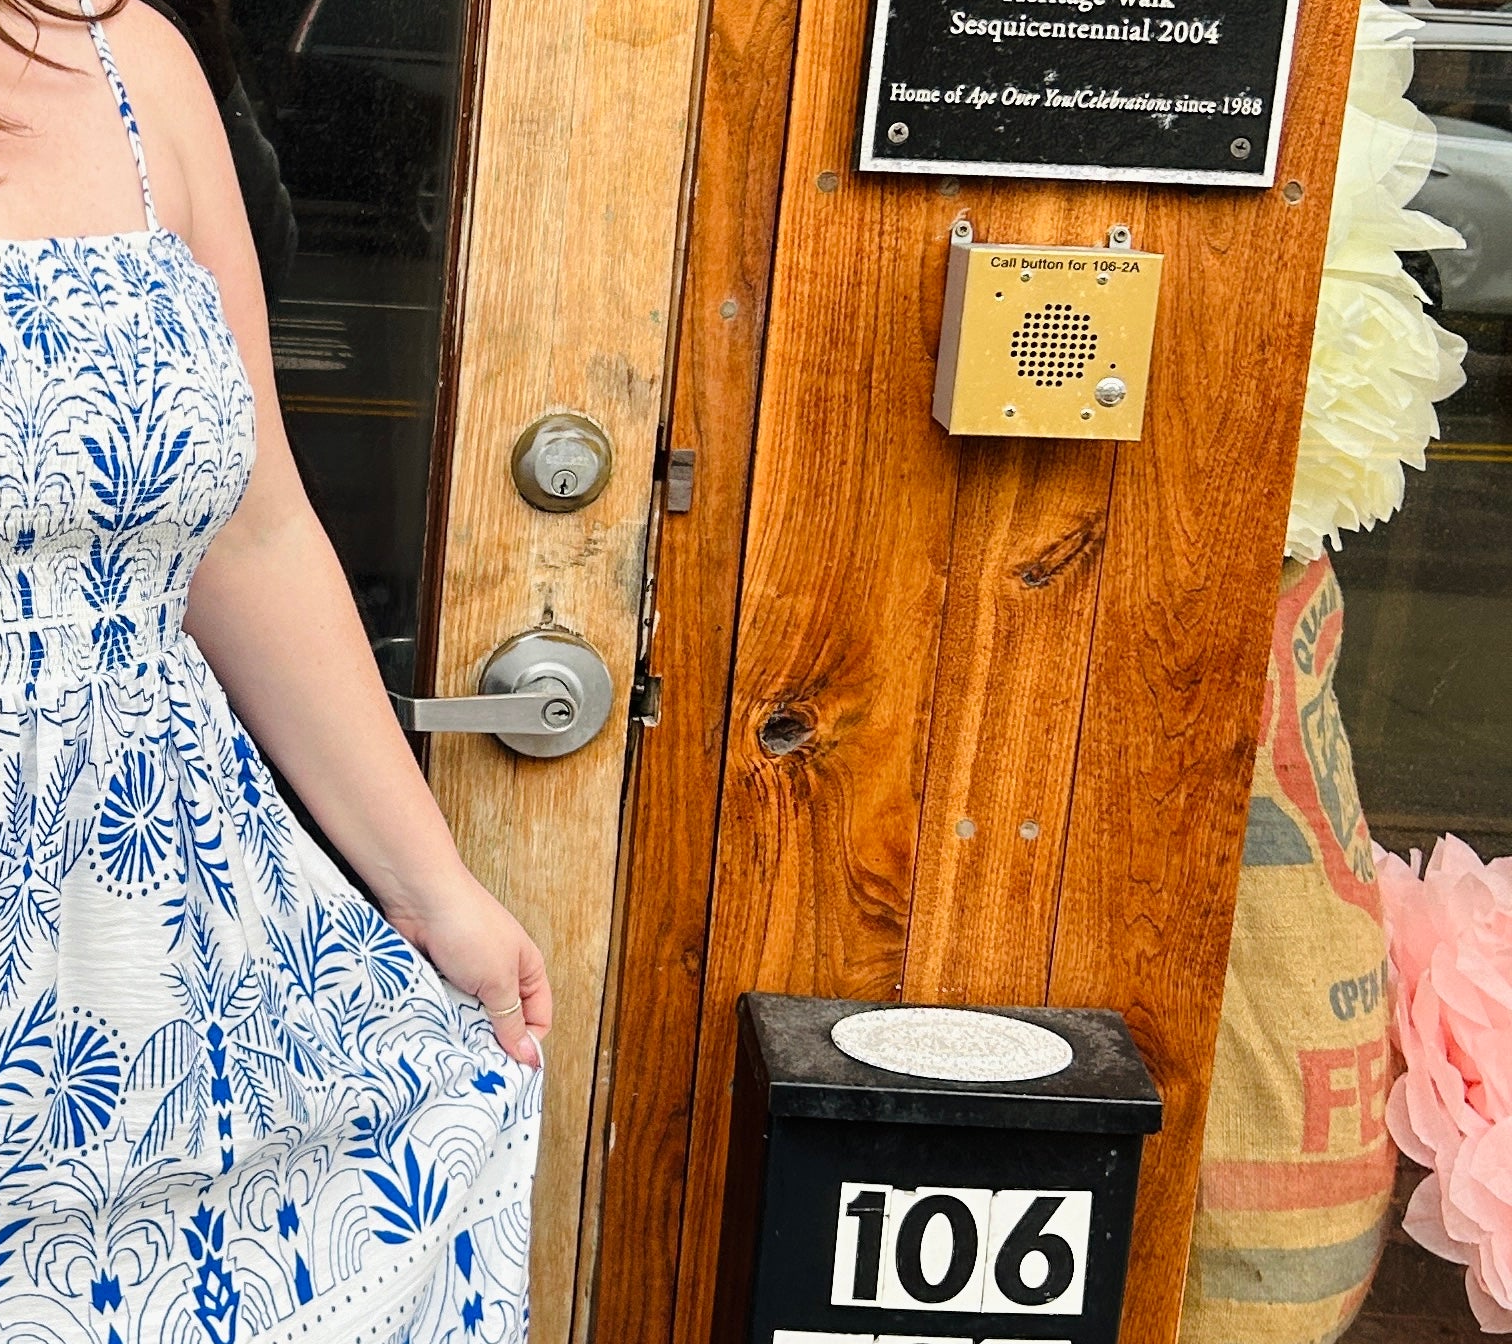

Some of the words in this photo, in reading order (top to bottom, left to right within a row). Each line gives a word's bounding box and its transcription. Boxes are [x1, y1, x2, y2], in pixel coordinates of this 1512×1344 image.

[949, 12, 1151, 43] Sesquicentennial
[1157, 19, 1221, 45] 2004
[890, 83, 941, 103] Home
[944, 85, 966, 104] of
[1001, 87, 1041, 107] Over
[1174, 93, 1218, 114] since
[1223, 95, 1263, 117] 1988
[990, 256, 1017, 269] Call
[1021, 258, 1064, 271] button
[1068, 259, 1088, 272] for
[1093, 260, 1141, 274] 106-2A
[846, 1189, 1075, 1306] 106
